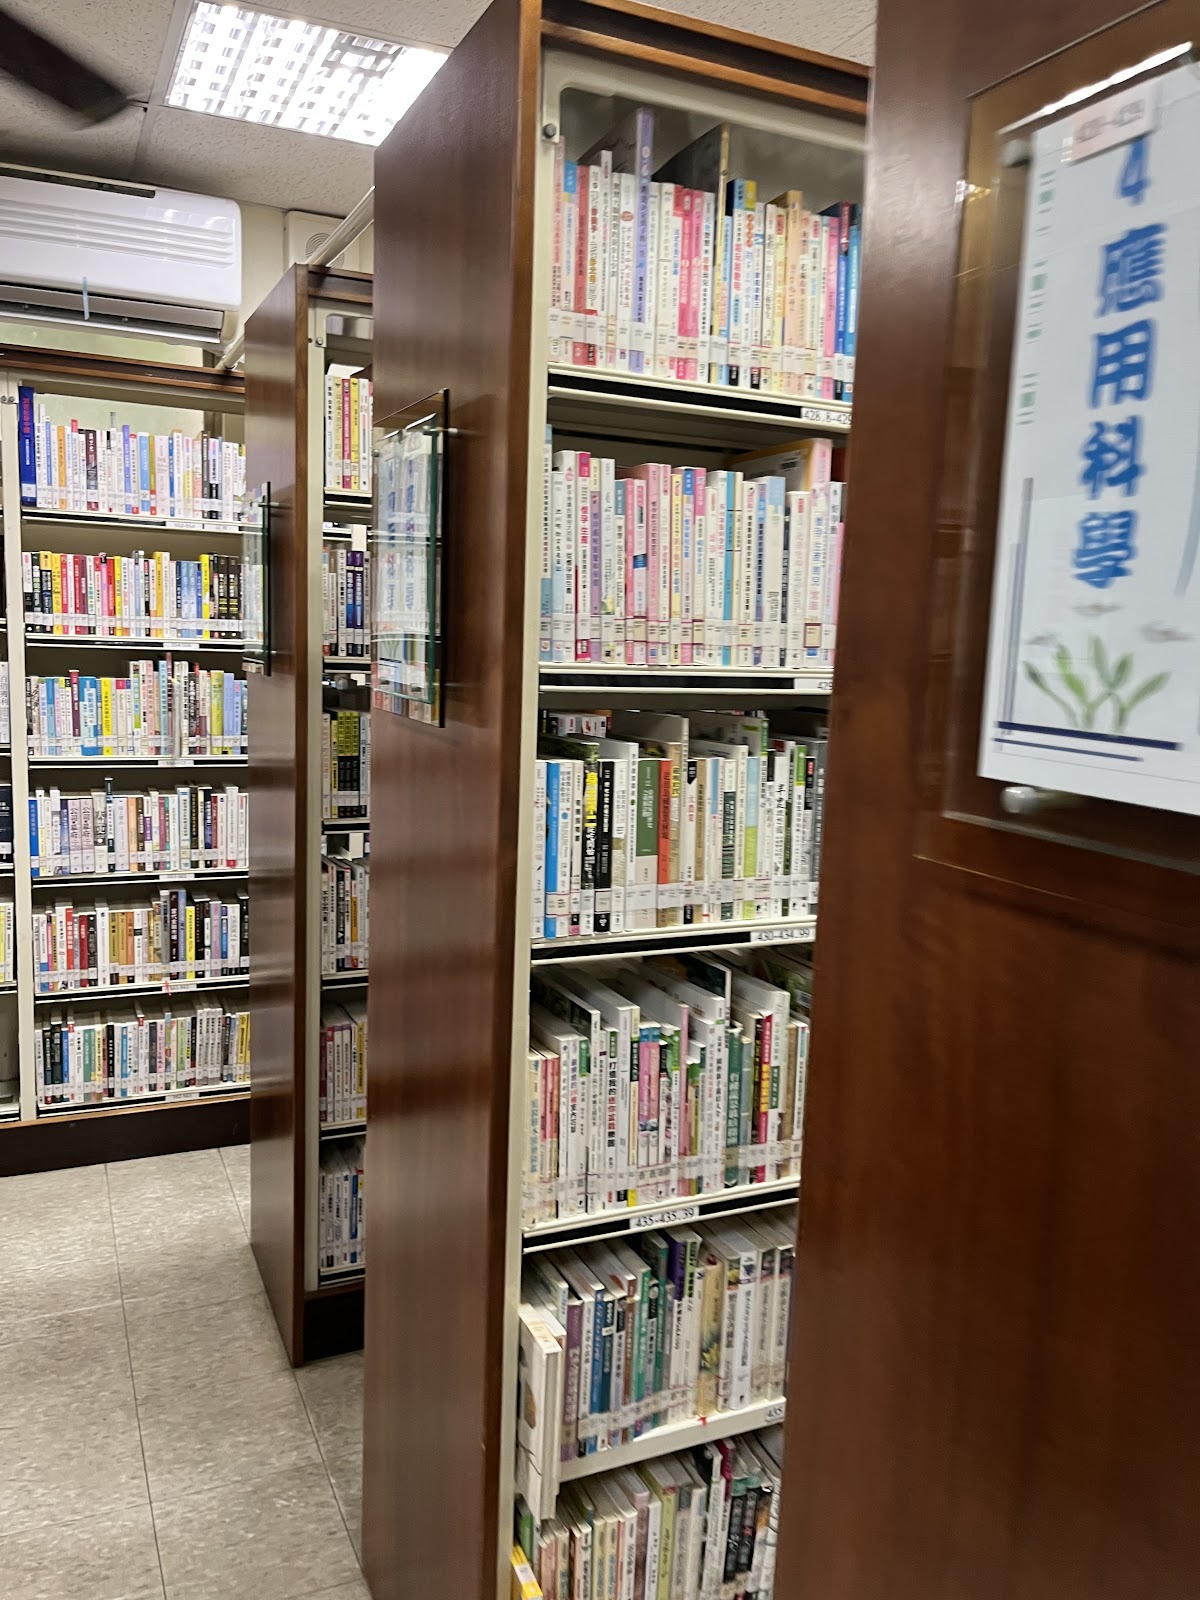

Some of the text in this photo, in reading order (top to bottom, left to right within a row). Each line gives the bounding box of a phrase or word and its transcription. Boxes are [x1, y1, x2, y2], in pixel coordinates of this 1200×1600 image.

[1072, 222, 1167, 590] 應用科學
[636, 1207, 695, 1228] 435-435.39
